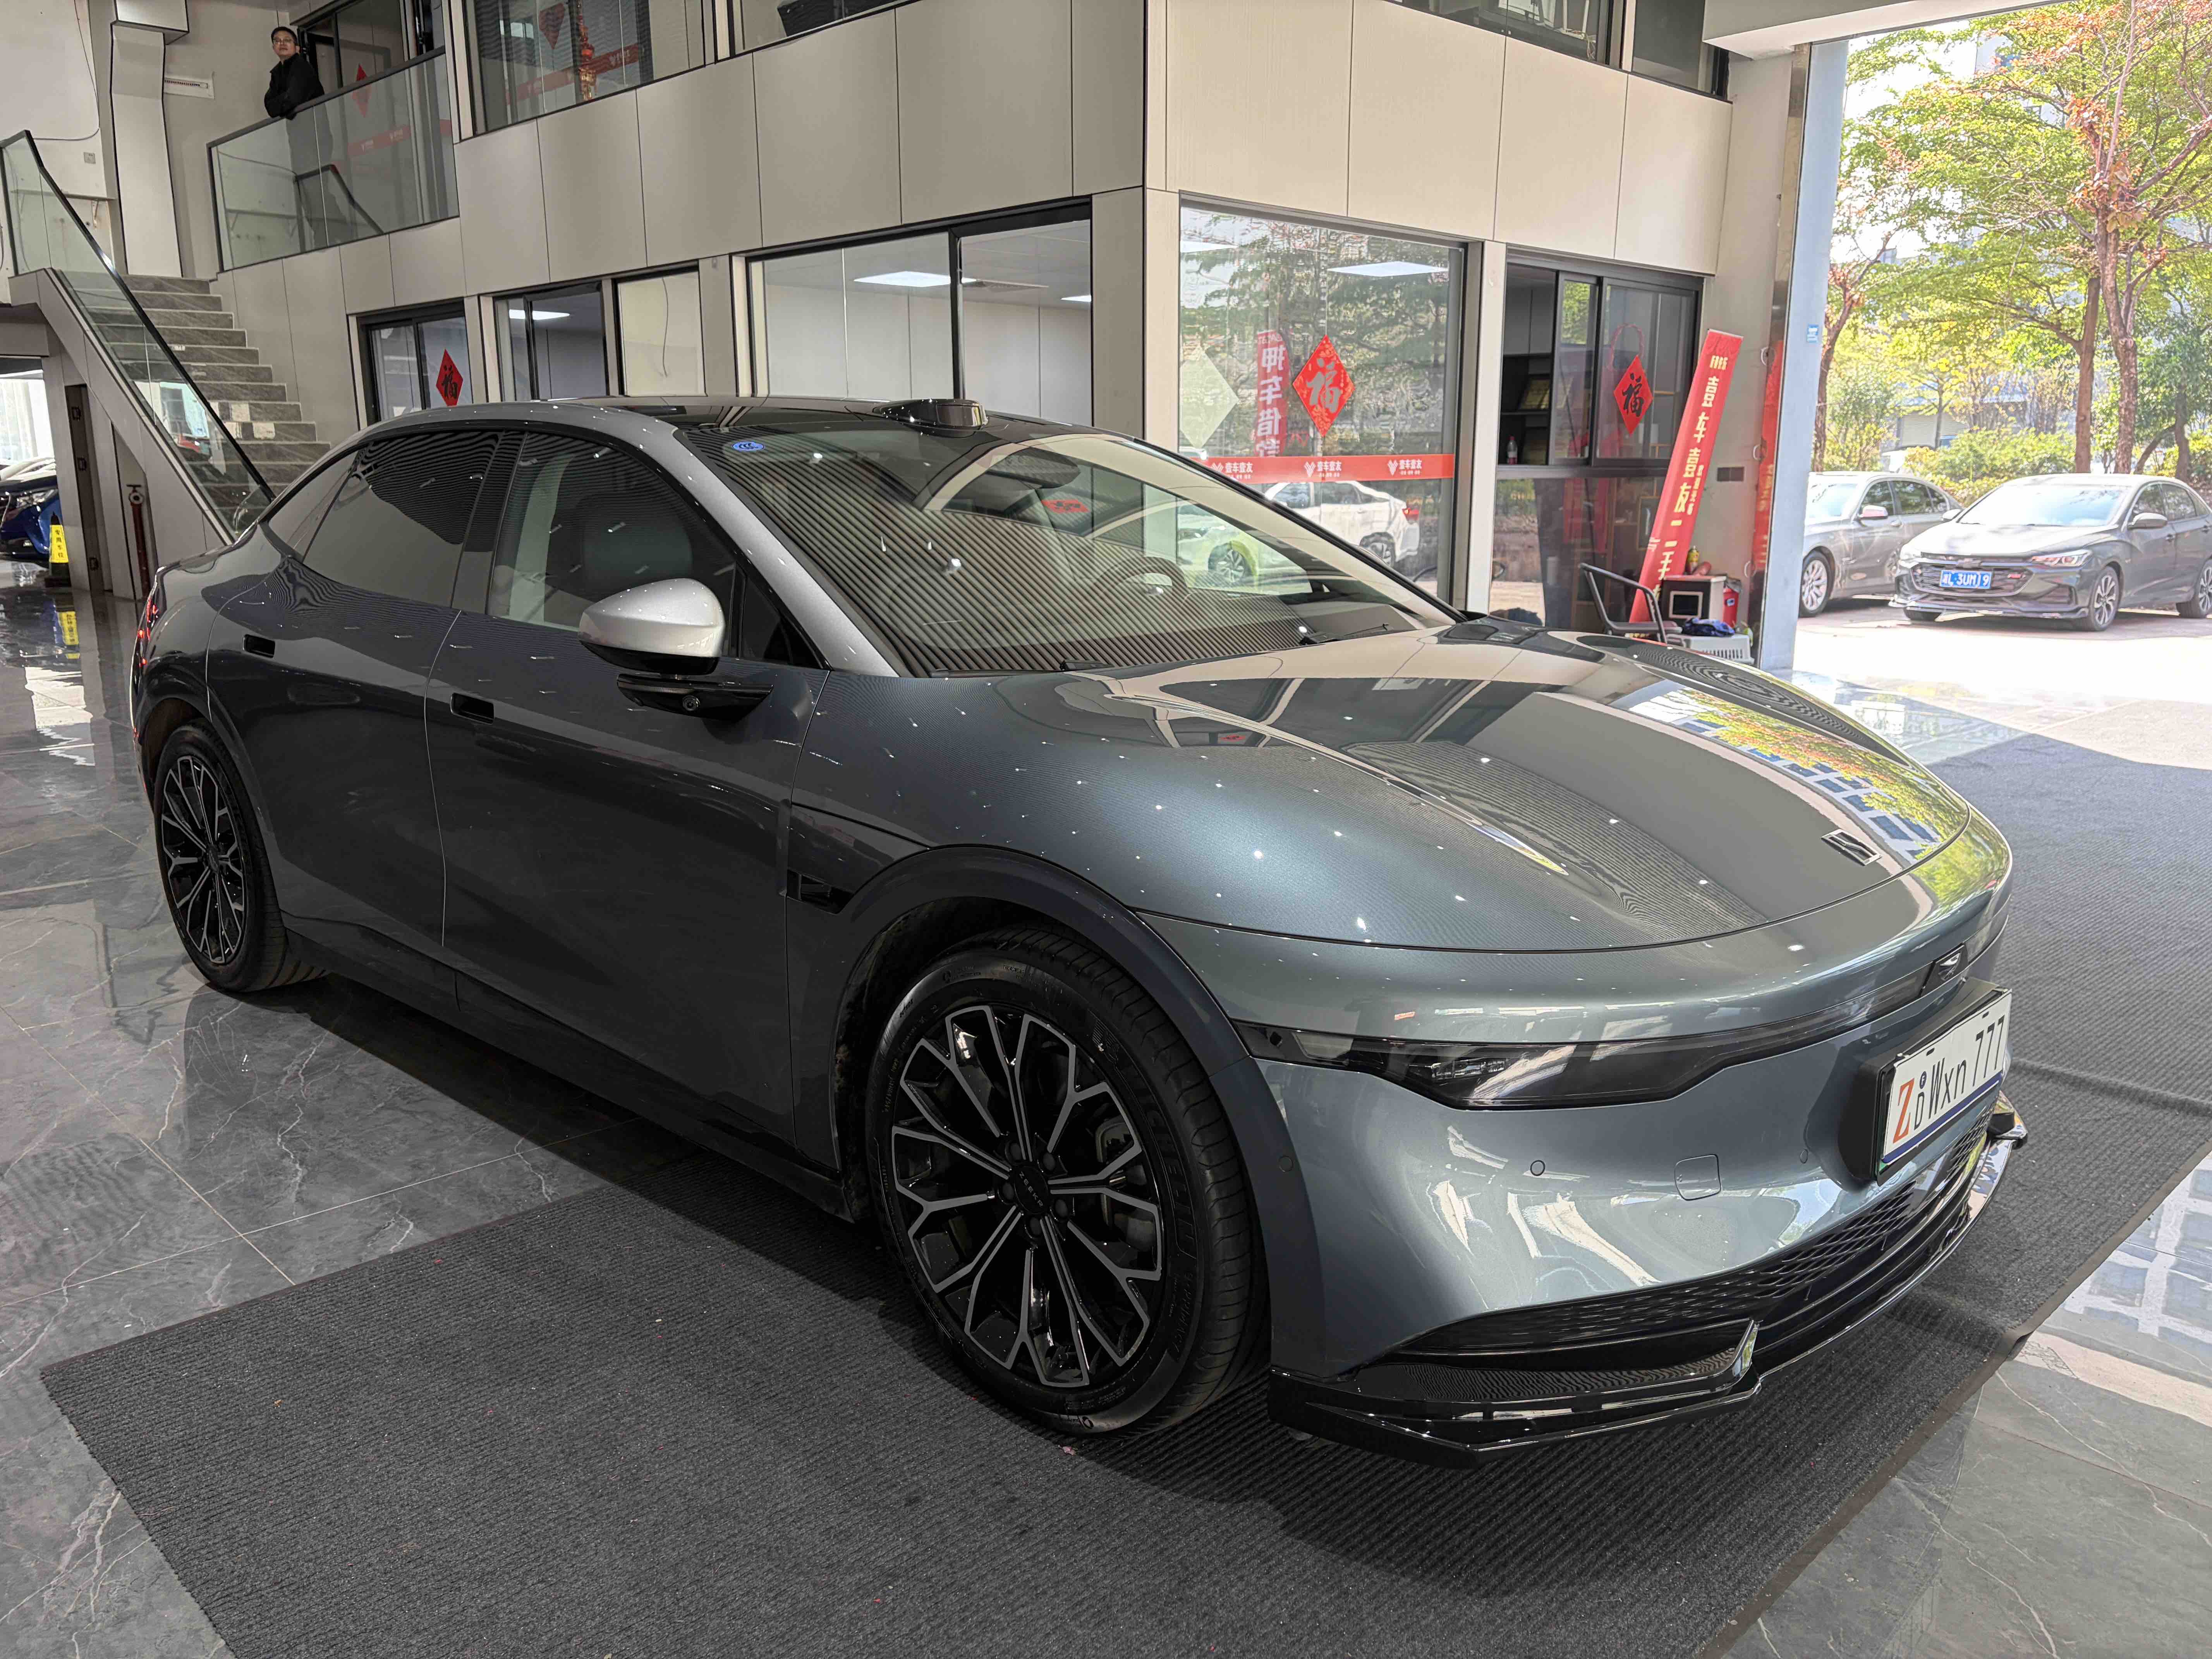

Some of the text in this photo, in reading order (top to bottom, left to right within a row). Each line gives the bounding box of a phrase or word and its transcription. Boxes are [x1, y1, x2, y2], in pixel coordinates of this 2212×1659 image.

[441, 365, 459, 400] 福
[1307, 359, 1342, 413] 福
[1622, 373, 1644, 417] 福
[1225, 462, 1253, 473] 壹车壹友
[1973, 1014, 2005, 1087] 777
[1019, 1171, 1043, 1207] ZEEKR
